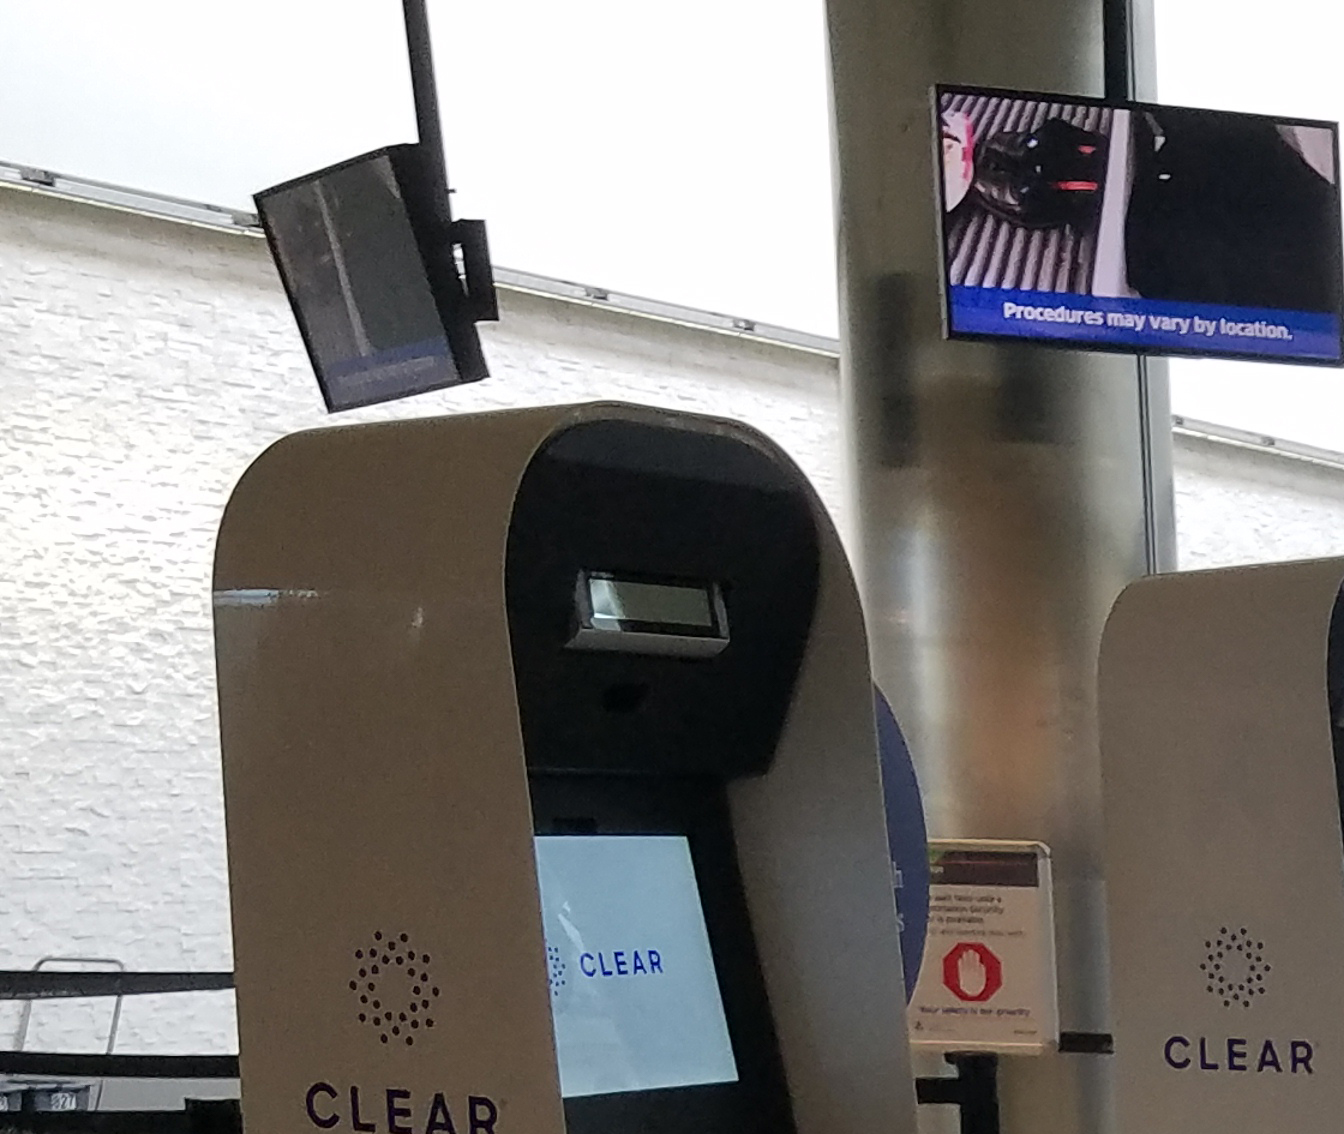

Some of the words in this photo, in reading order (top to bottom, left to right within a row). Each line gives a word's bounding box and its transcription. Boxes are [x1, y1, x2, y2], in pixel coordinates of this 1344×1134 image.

[1003, 302, 1102, 325] Procedures
[1107, 312, 1145, 331] may
[1150, 314, 1189, 334] vary
[1194, 316, 1216, 336] by
[1219, 318, 1293, 340] location.
[580, 950, 663, 977] CLEAR
[1164, 1036, 1313, 1074] CLEAR
